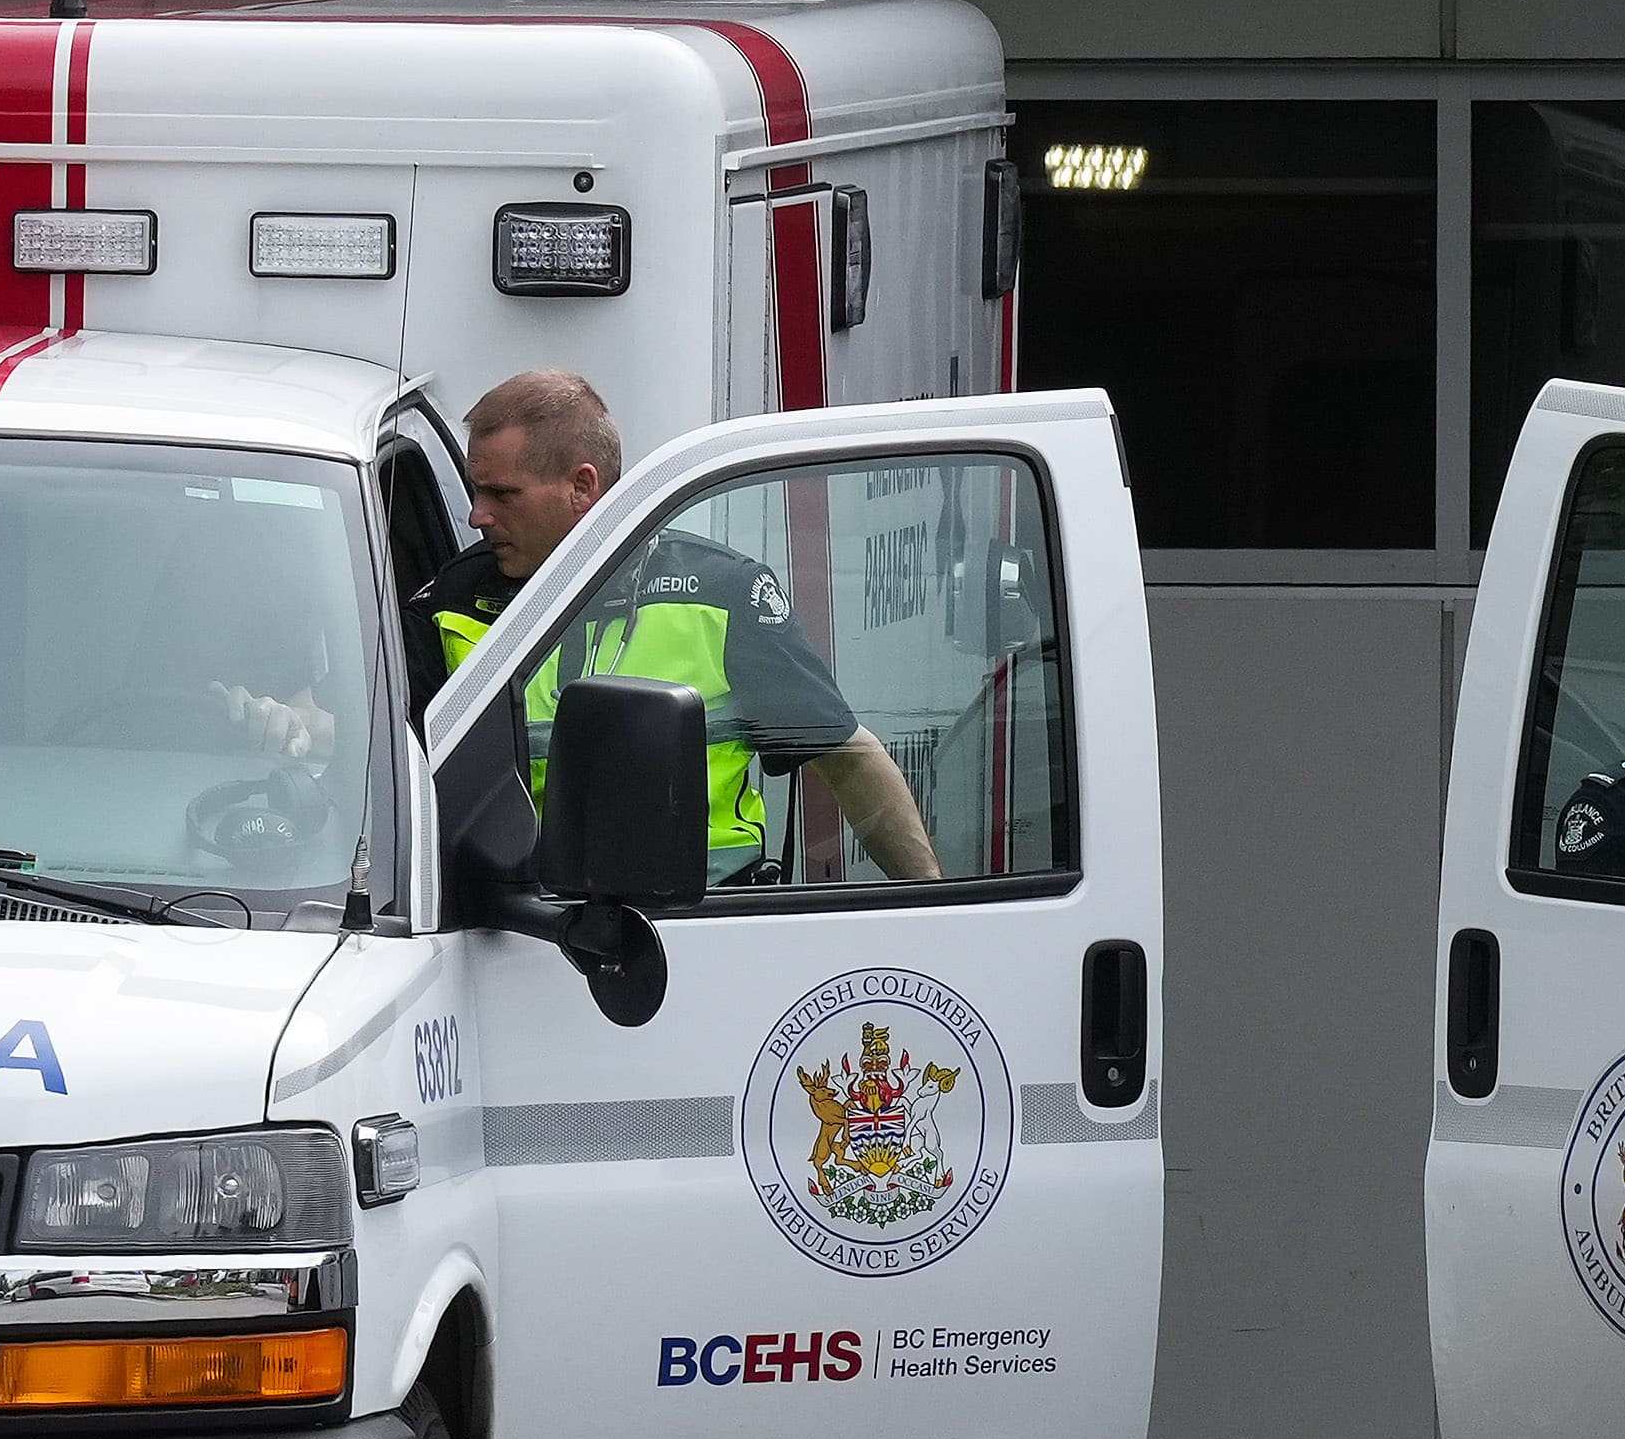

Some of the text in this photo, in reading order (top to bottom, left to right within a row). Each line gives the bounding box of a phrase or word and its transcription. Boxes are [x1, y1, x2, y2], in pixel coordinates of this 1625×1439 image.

[864, 519, 928, 631] PARAMEDIC
[768, 975, 983, 1060] BRITISH COLUMBIA
[415, 1015, 462, 1105] 63812
[869, 1192, 894, 1202] SINE
[897, 1175, 935, 1195] OCCASU
[761, 1167, 1000, 1270] AMBULANCE SERVICE
[657, 1330, 863, 1387] BCEHS
[890, 1355, 1057, 1378] Health Services
[892, 1327, 1052, 1351] BC Emergency
